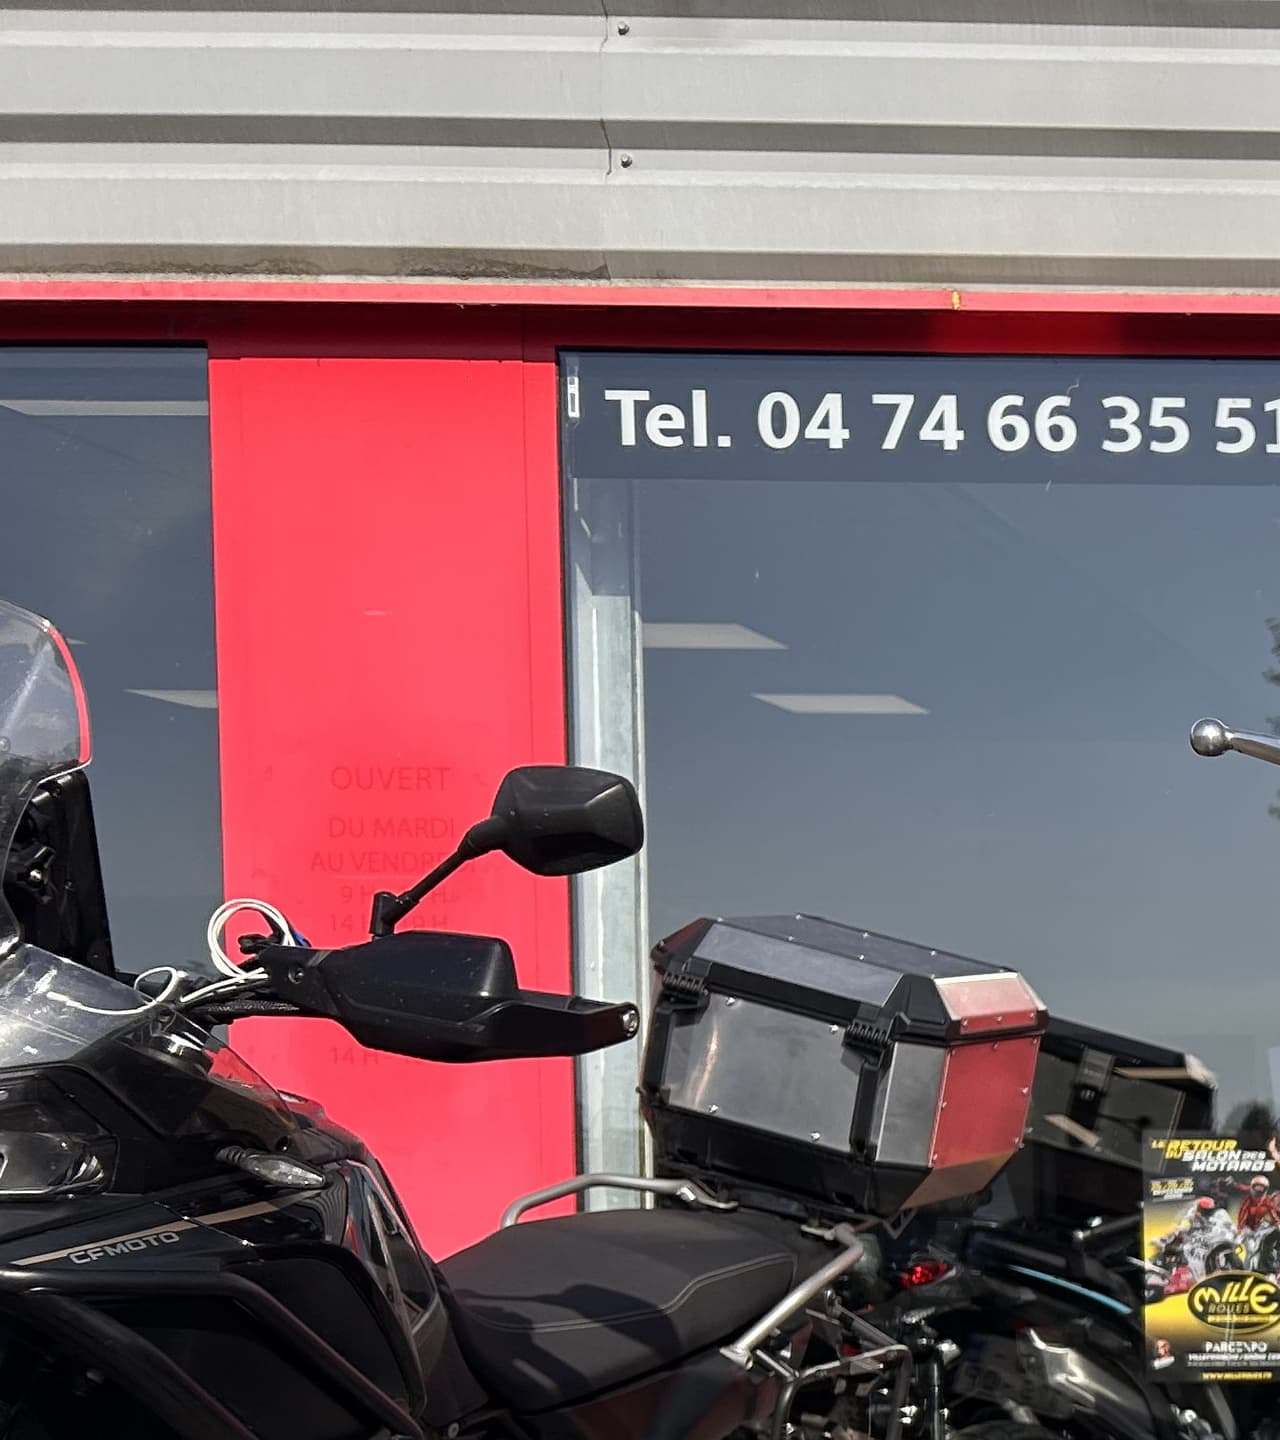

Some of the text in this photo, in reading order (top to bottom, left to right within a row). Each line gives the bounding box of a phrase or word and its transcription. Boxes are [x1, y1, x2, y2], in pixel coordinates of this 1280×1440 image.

[605, 389, 732, 448] Tel.
[757, 391, 850, 450] 04
[870, 393, 965, 452] 74
[986, 394, 1079, 453] 66
[1101, 395, 1191, 454] 35
[330, 765, 452, 791] OUVERT
[328, 816, 455, 839] DU MARDI
[309, 851, 477, 873] AU VENDRI
[1167, 1139, 1238, 1151] RETOUR
[1181, 1149, 1242, 1162] SALON
[1242, 1151, 1266, 1160] DES
[1191, 1160, 1276, 1172] MOTARDS
[69, 1231, 180, 1264] CFMOTO
